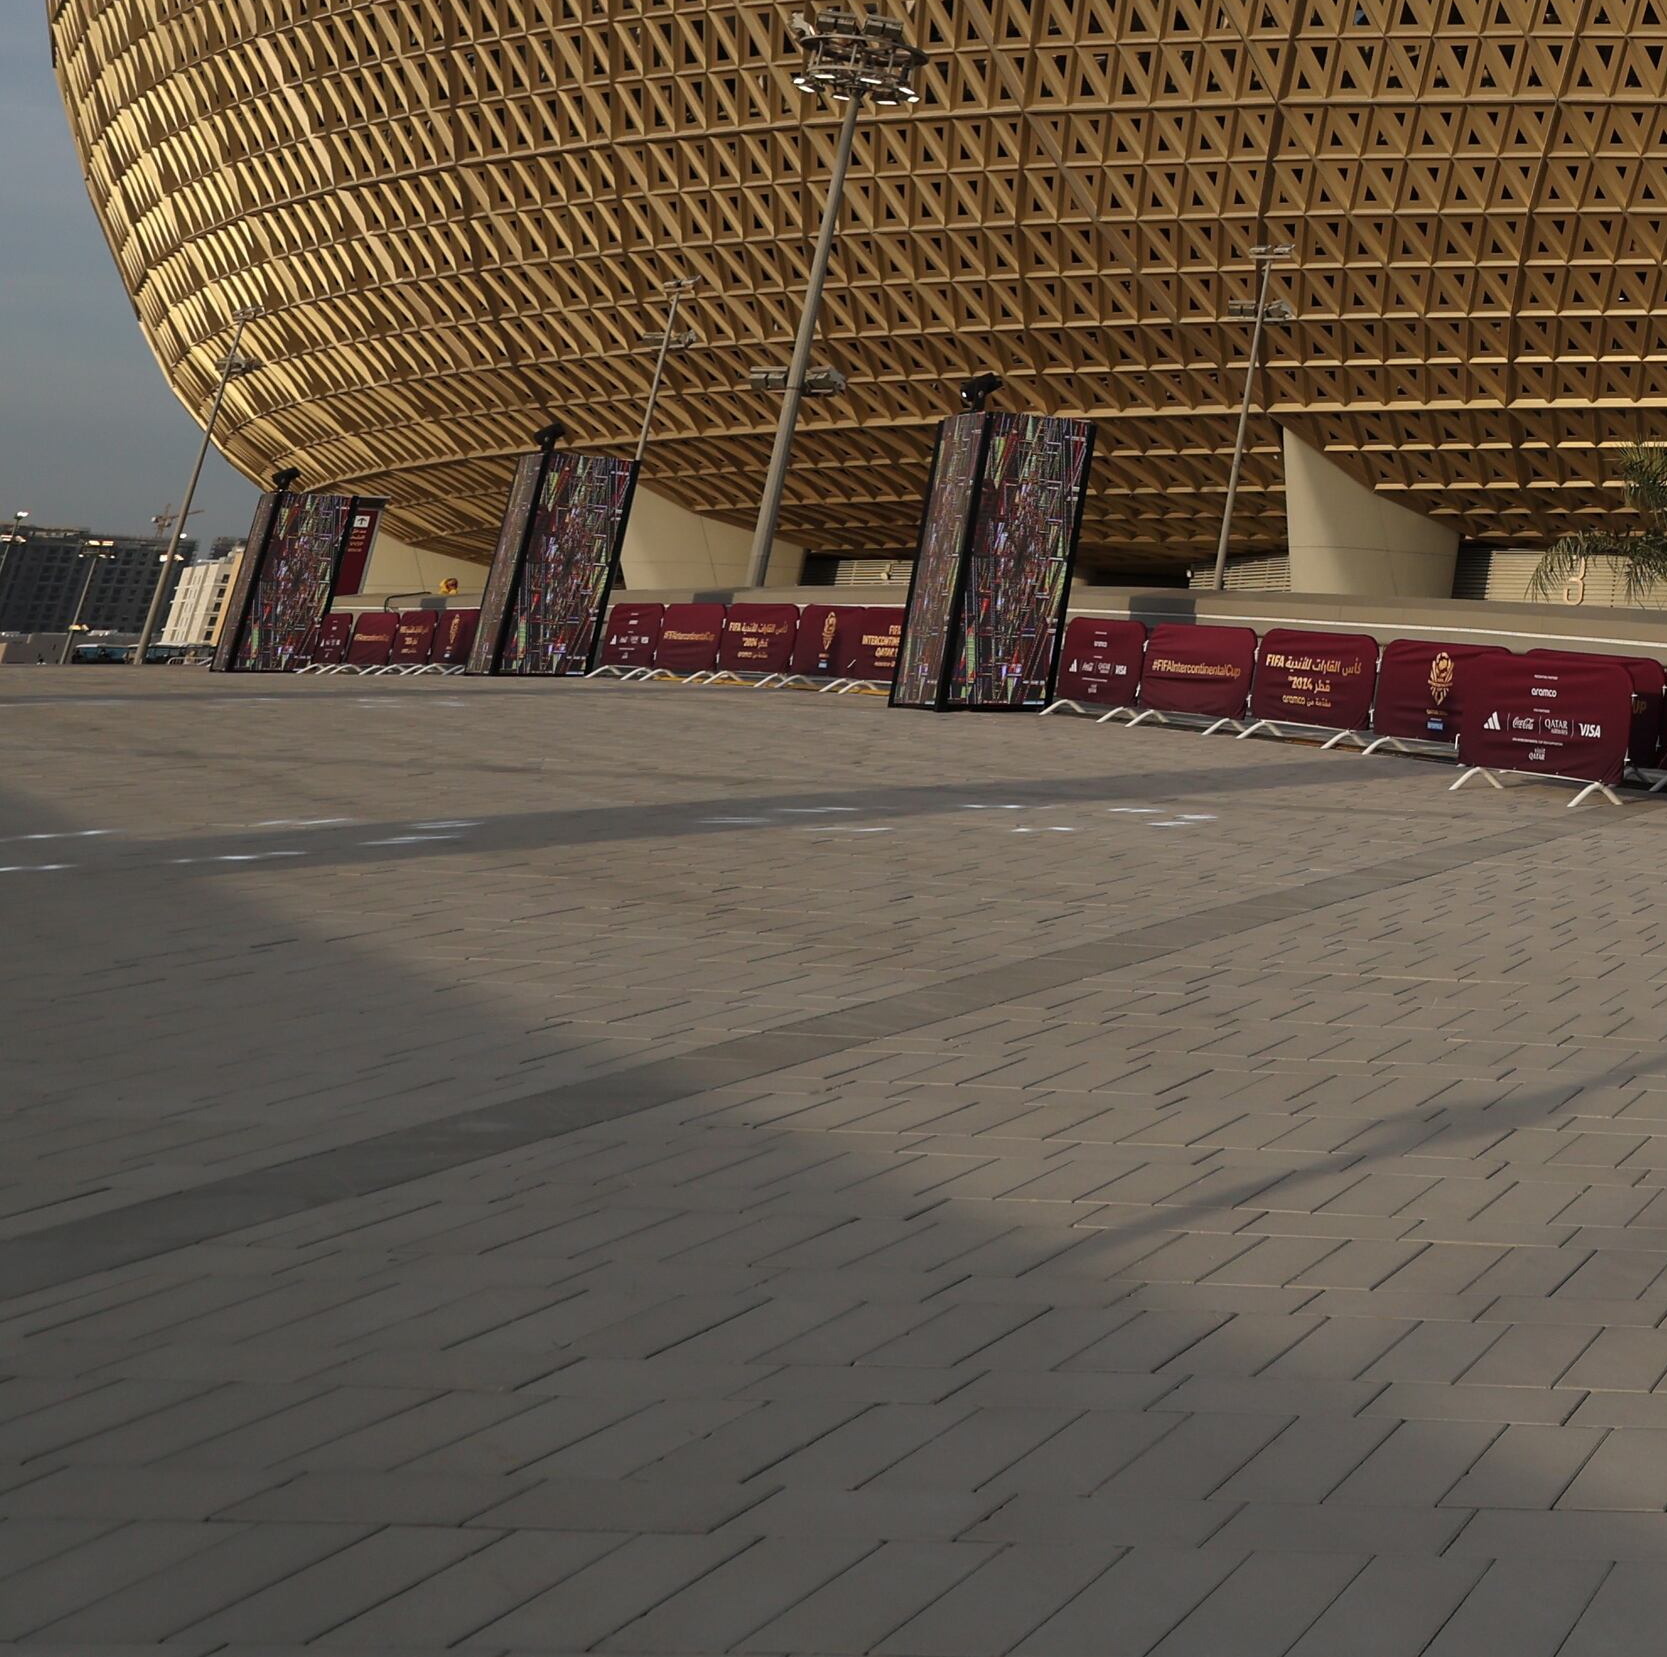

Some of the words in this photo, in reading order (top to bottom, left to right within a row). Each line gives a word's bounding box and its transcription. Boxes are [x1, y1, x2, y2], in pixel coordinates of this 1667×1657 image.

[1266, 654, 1284, 668] FIFA
[1531, 688, 1557, 698] aramco
[1544, 718, 1568, 729] QATAR
[1578, 723, 1600, 738] VISA
